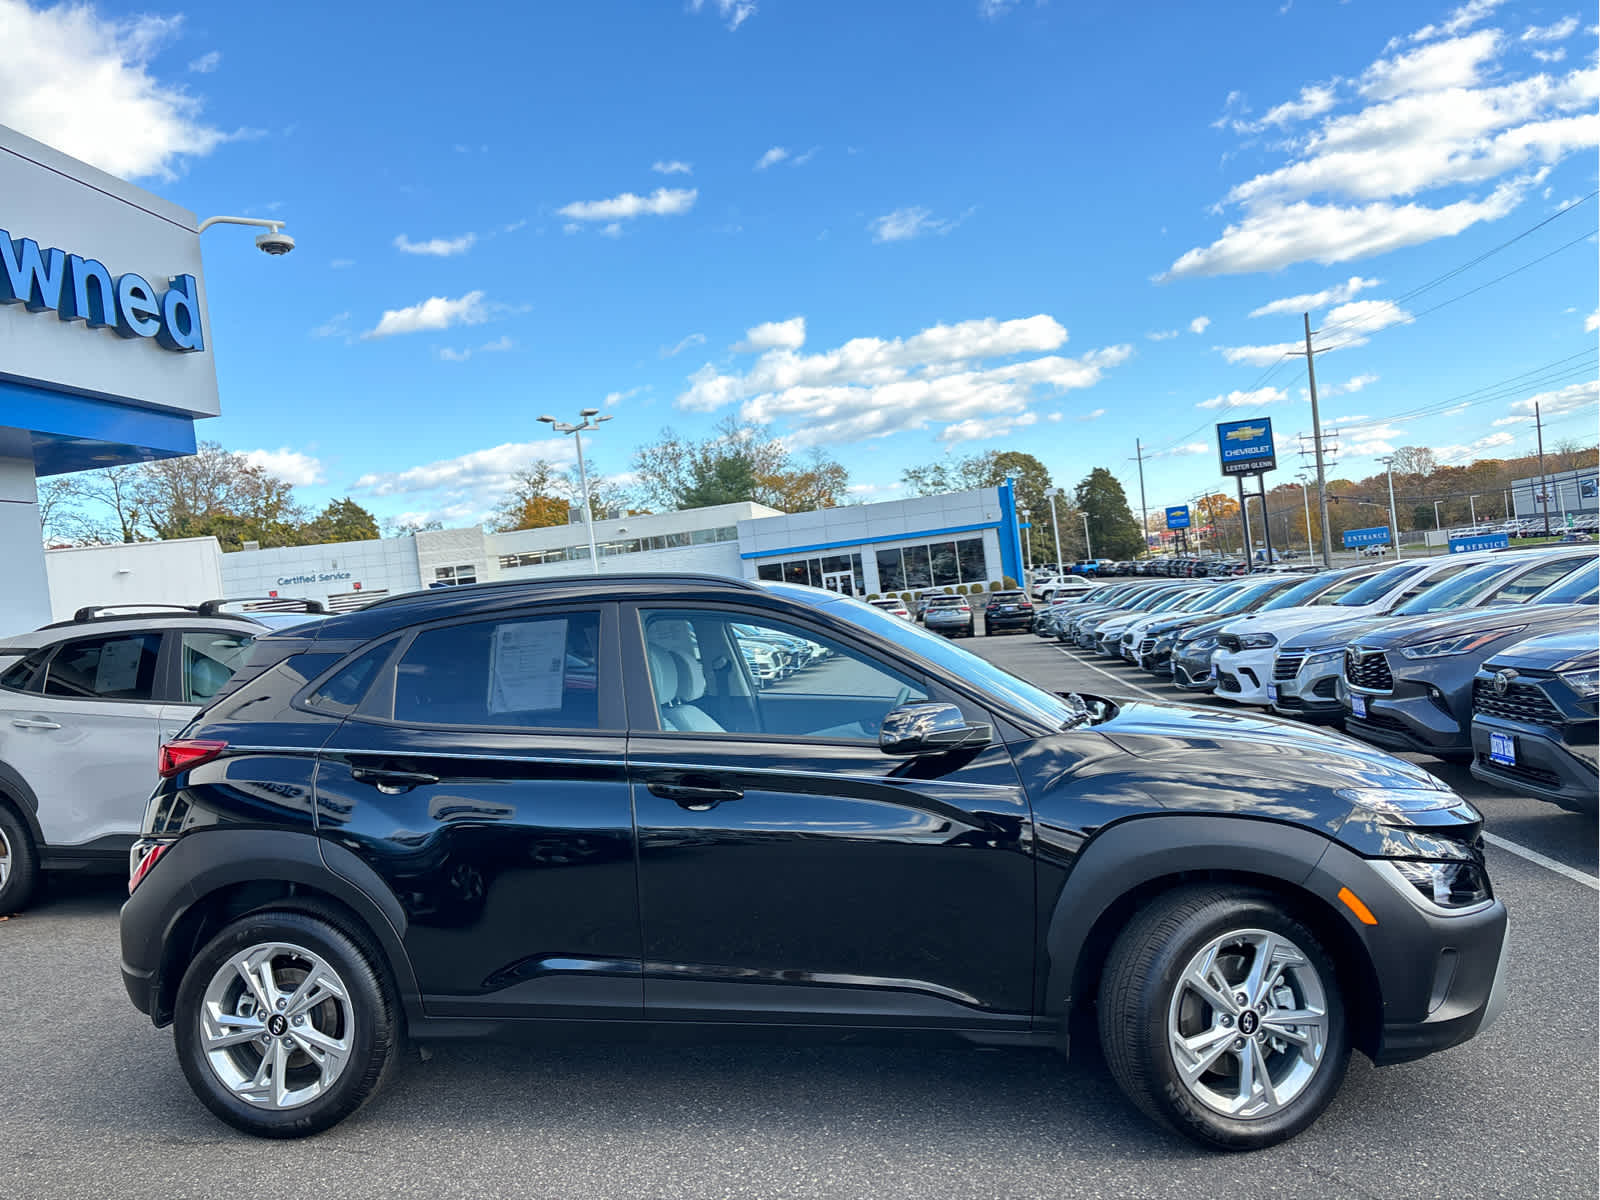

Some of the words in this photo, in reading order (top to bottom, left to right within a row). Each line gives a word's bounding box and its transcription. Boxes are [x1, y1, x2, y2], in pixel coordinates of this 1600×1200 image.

[1225, 445, 1270, 457] CHEVROLET
[1225, 462, 1250, 472] LESTER
[1250, 461, 1273, 470] GLENN
[1347, 532, 1388, 543] ENTRANCE
[1464, 540, 1507, 551] SERVICE
[277, 574, 316, 586] Certified
[318, 572, 351, 582] Service
